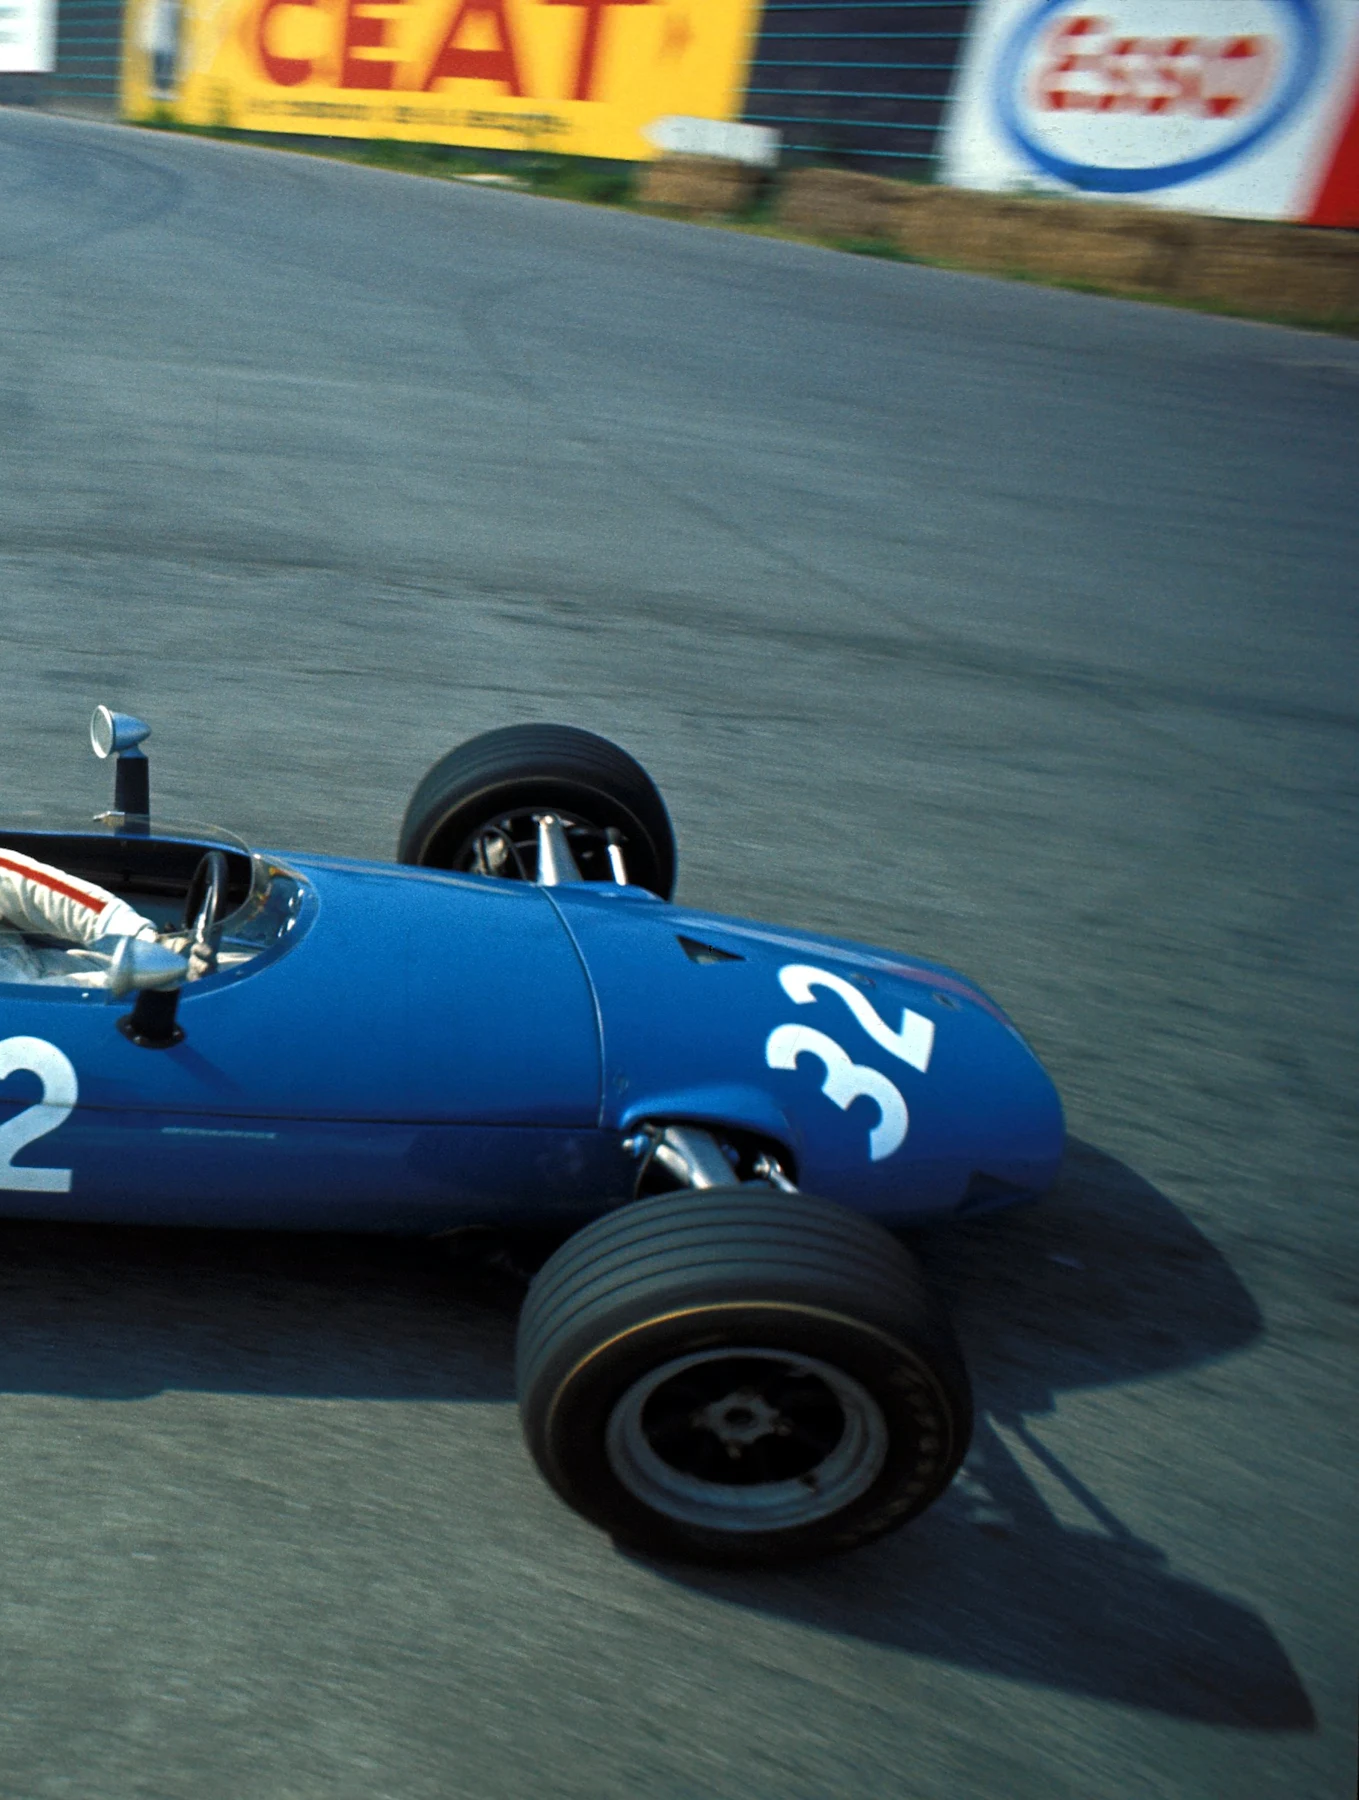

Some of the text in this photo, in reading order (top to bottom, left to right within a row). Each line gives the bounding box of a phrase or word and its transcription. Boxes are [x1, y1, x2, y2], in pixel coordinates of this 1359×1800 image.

[248, 0, 658, 101] CEAT
[1036, 15, 1272, 118] Esso
[765, 963, 936, 1163] 32
